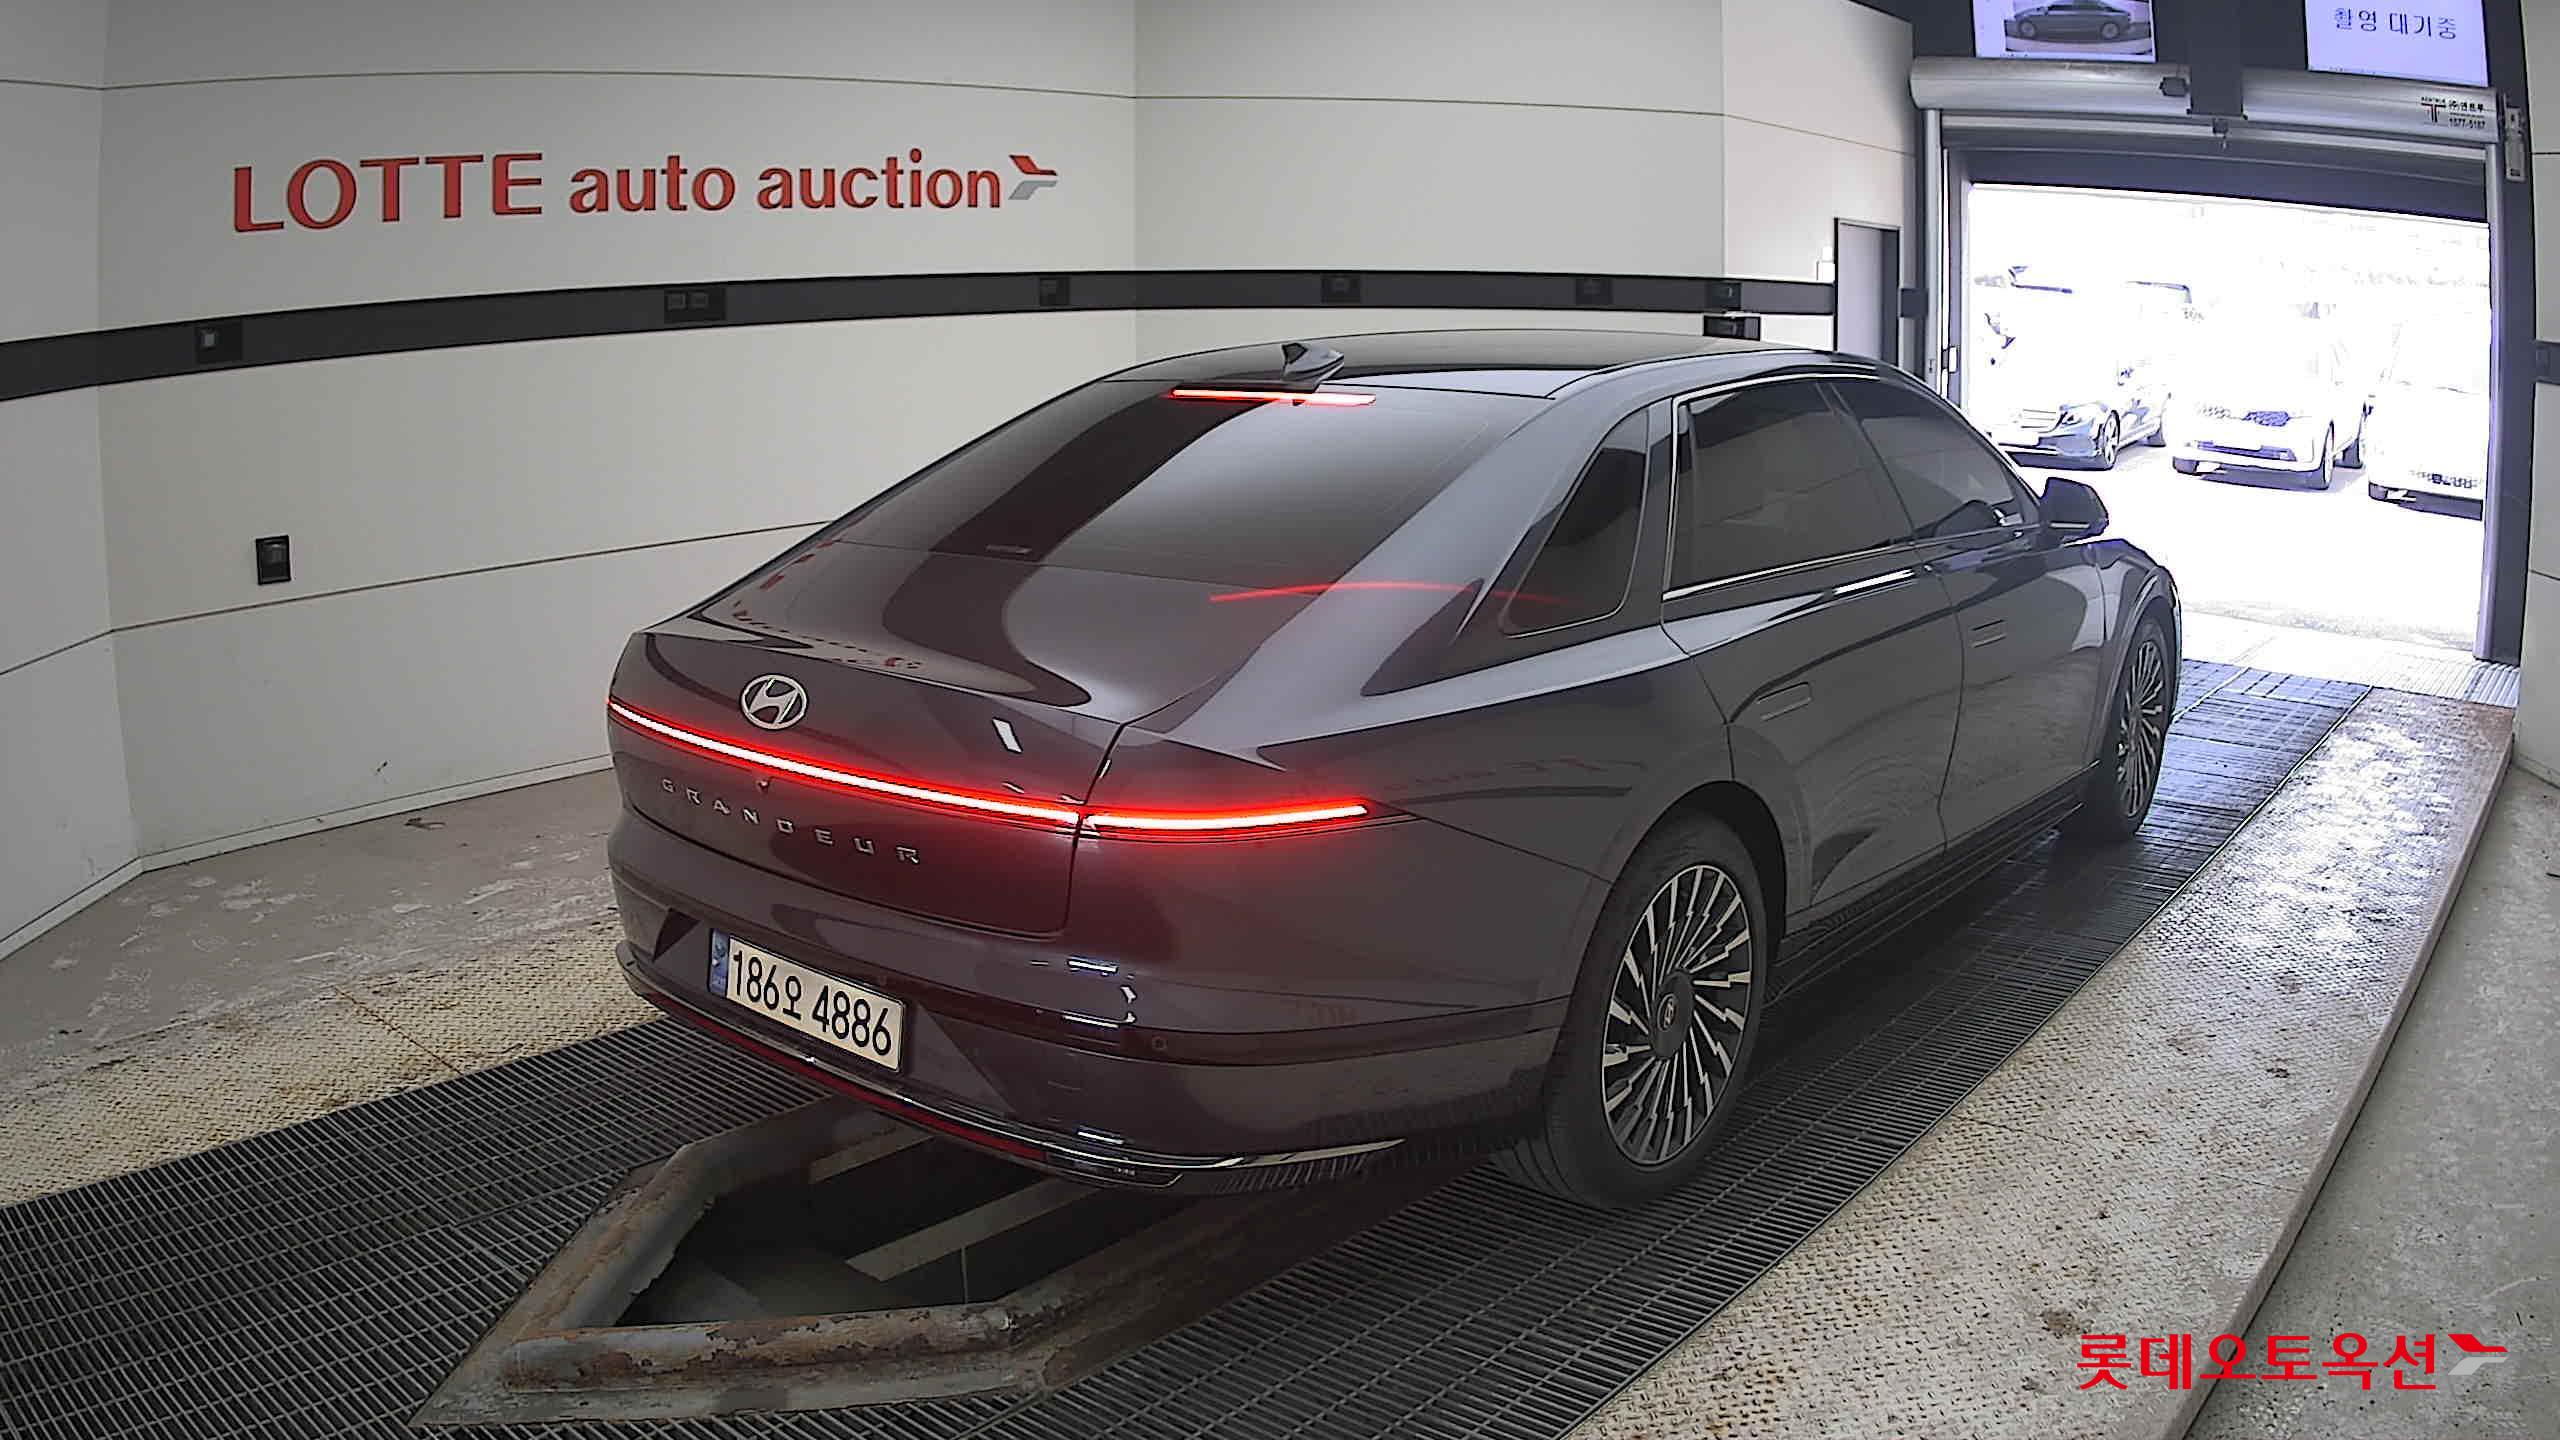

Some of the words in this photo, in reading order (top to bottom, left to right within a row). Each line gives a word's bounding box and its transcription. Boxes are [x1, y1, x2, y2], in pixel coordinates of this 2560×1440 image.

[2389, 12, 2457, 40] 대기중
[233, 152, 544, 233] LOTTE
[568, 154, 736, 214] auto
[756, 147, 1002, 210] auction
[661, 778, 920, 864] GRANDEUR
[733, 950, 802, 1021] 186오
[811, 985, 892, 1056] 4886
